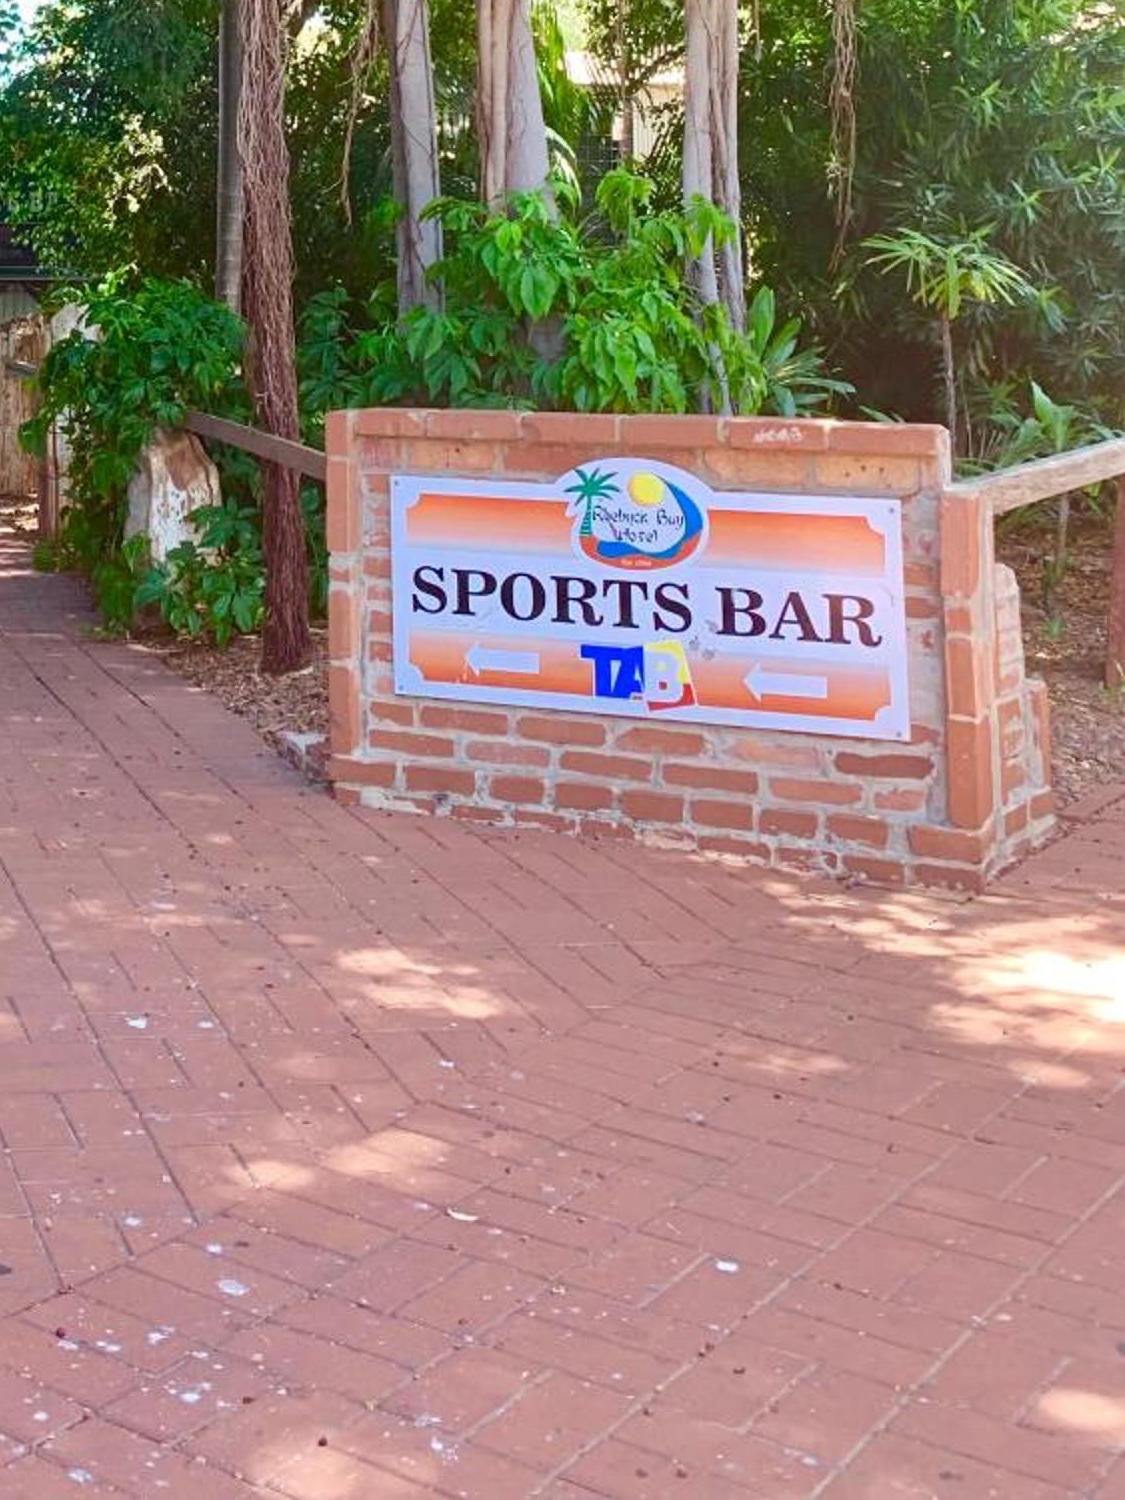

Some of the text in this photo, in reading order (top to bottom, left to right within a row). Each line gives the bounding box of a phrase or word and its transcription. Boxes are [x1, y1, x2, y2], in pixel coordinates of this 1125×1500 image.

[615, 528, 658, 543] Hotel
[657, 508, 684, 530] Bay
[412, 565, 882, 647] SPORTS BAR
[581, 641, 697, 712] TAB
